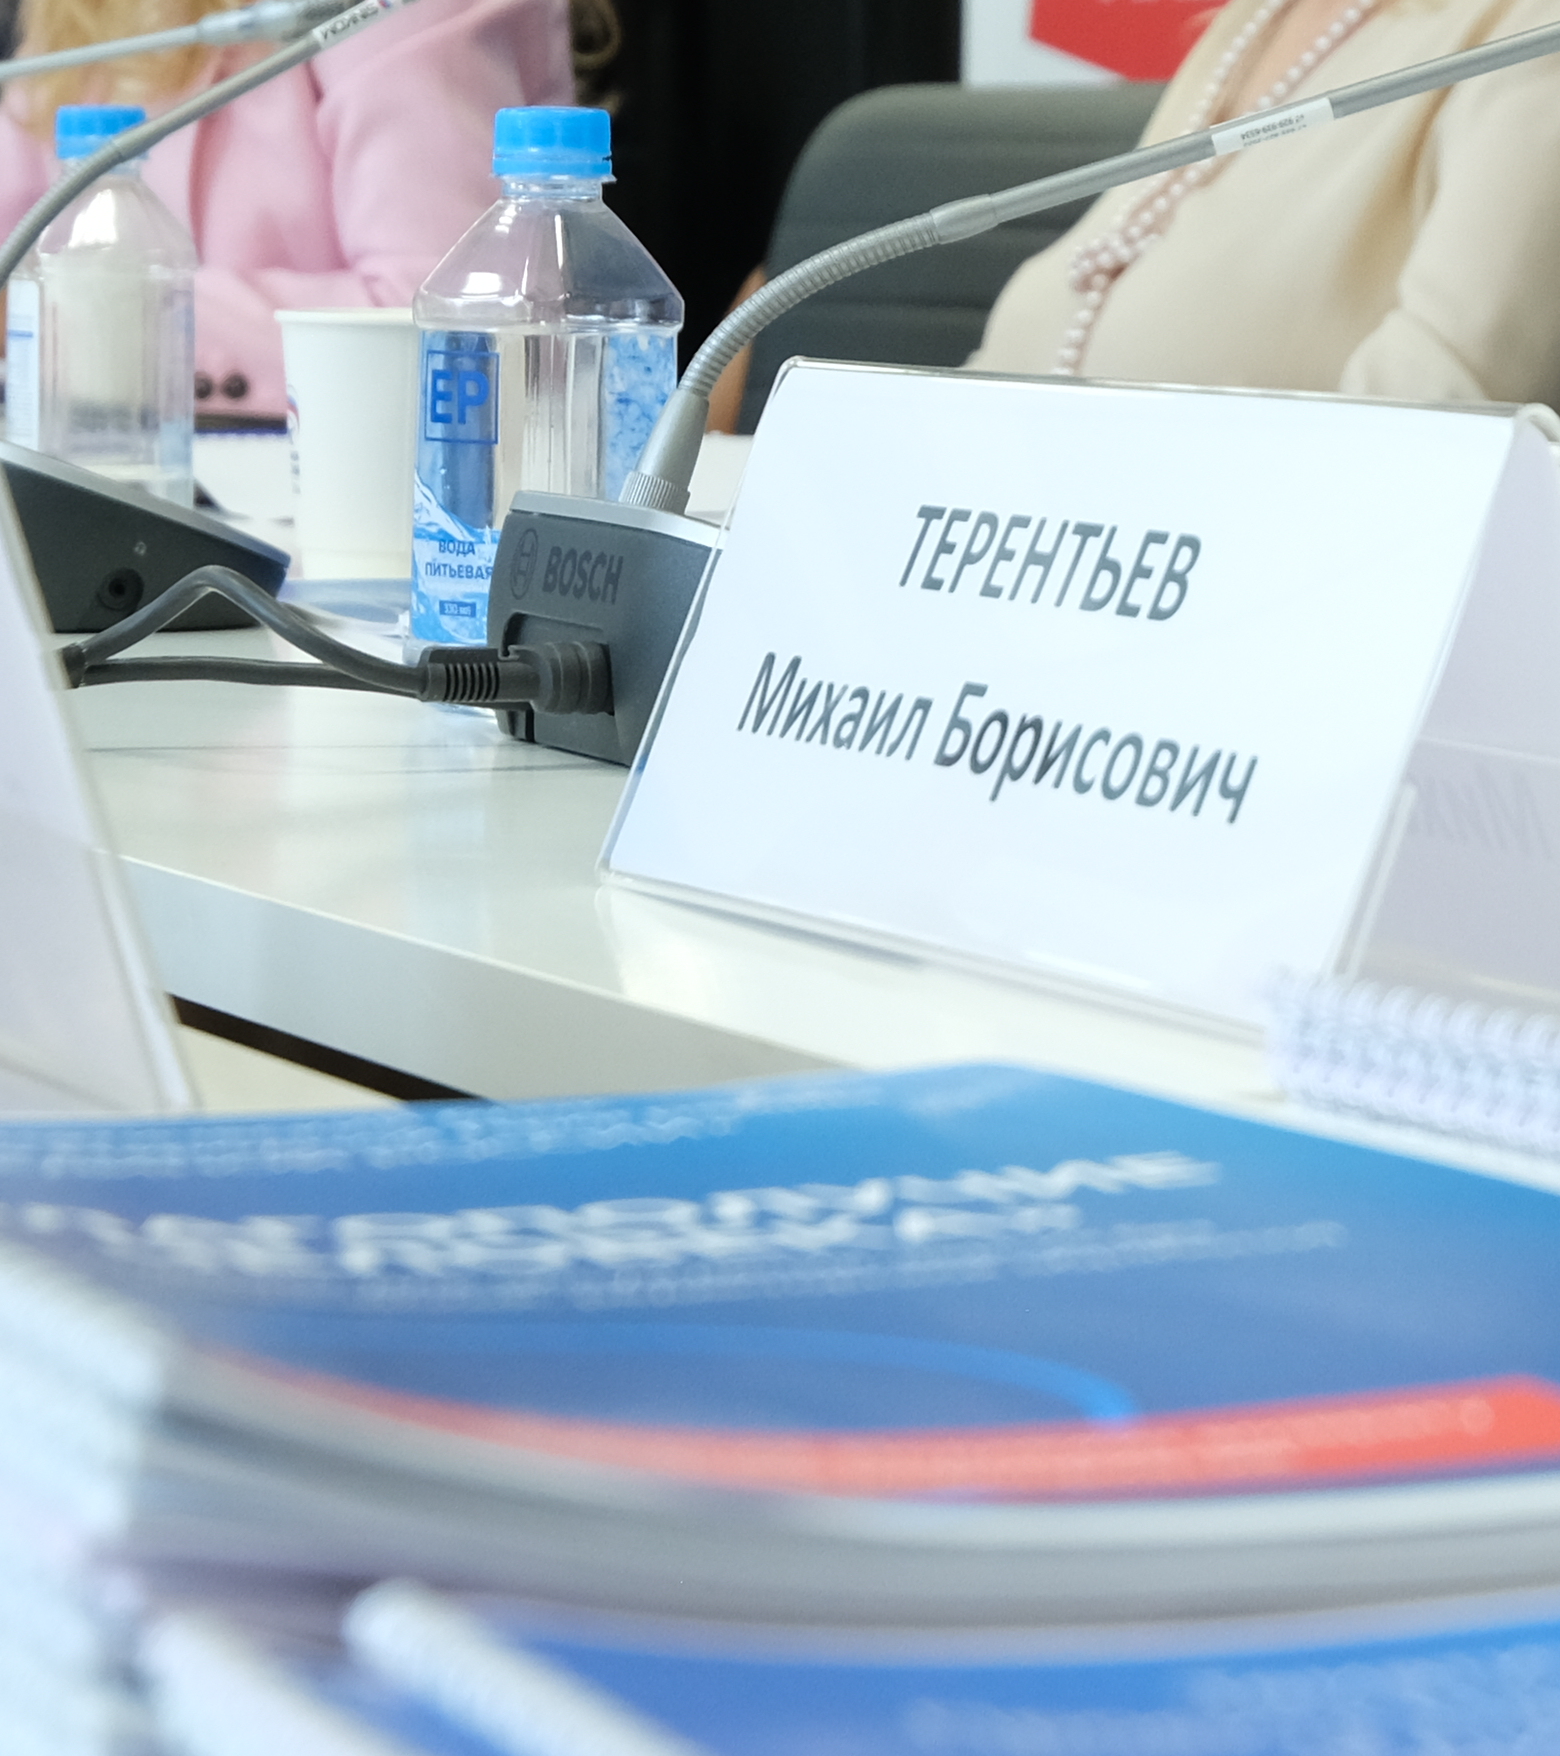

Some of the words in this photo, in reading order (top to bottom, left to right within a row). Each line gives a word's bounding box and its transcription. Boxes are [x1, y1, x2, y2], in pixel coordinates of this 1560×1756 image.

[438, 539, 476, 556] ВОДА
[542, 546, 625, 605] BOSCH
[897, 504, 1202, 622] ТЕРЕНТЬЕВ
[736, 651, 932, 761] Михаил
[934, 682, 1259, 825] Борисович
